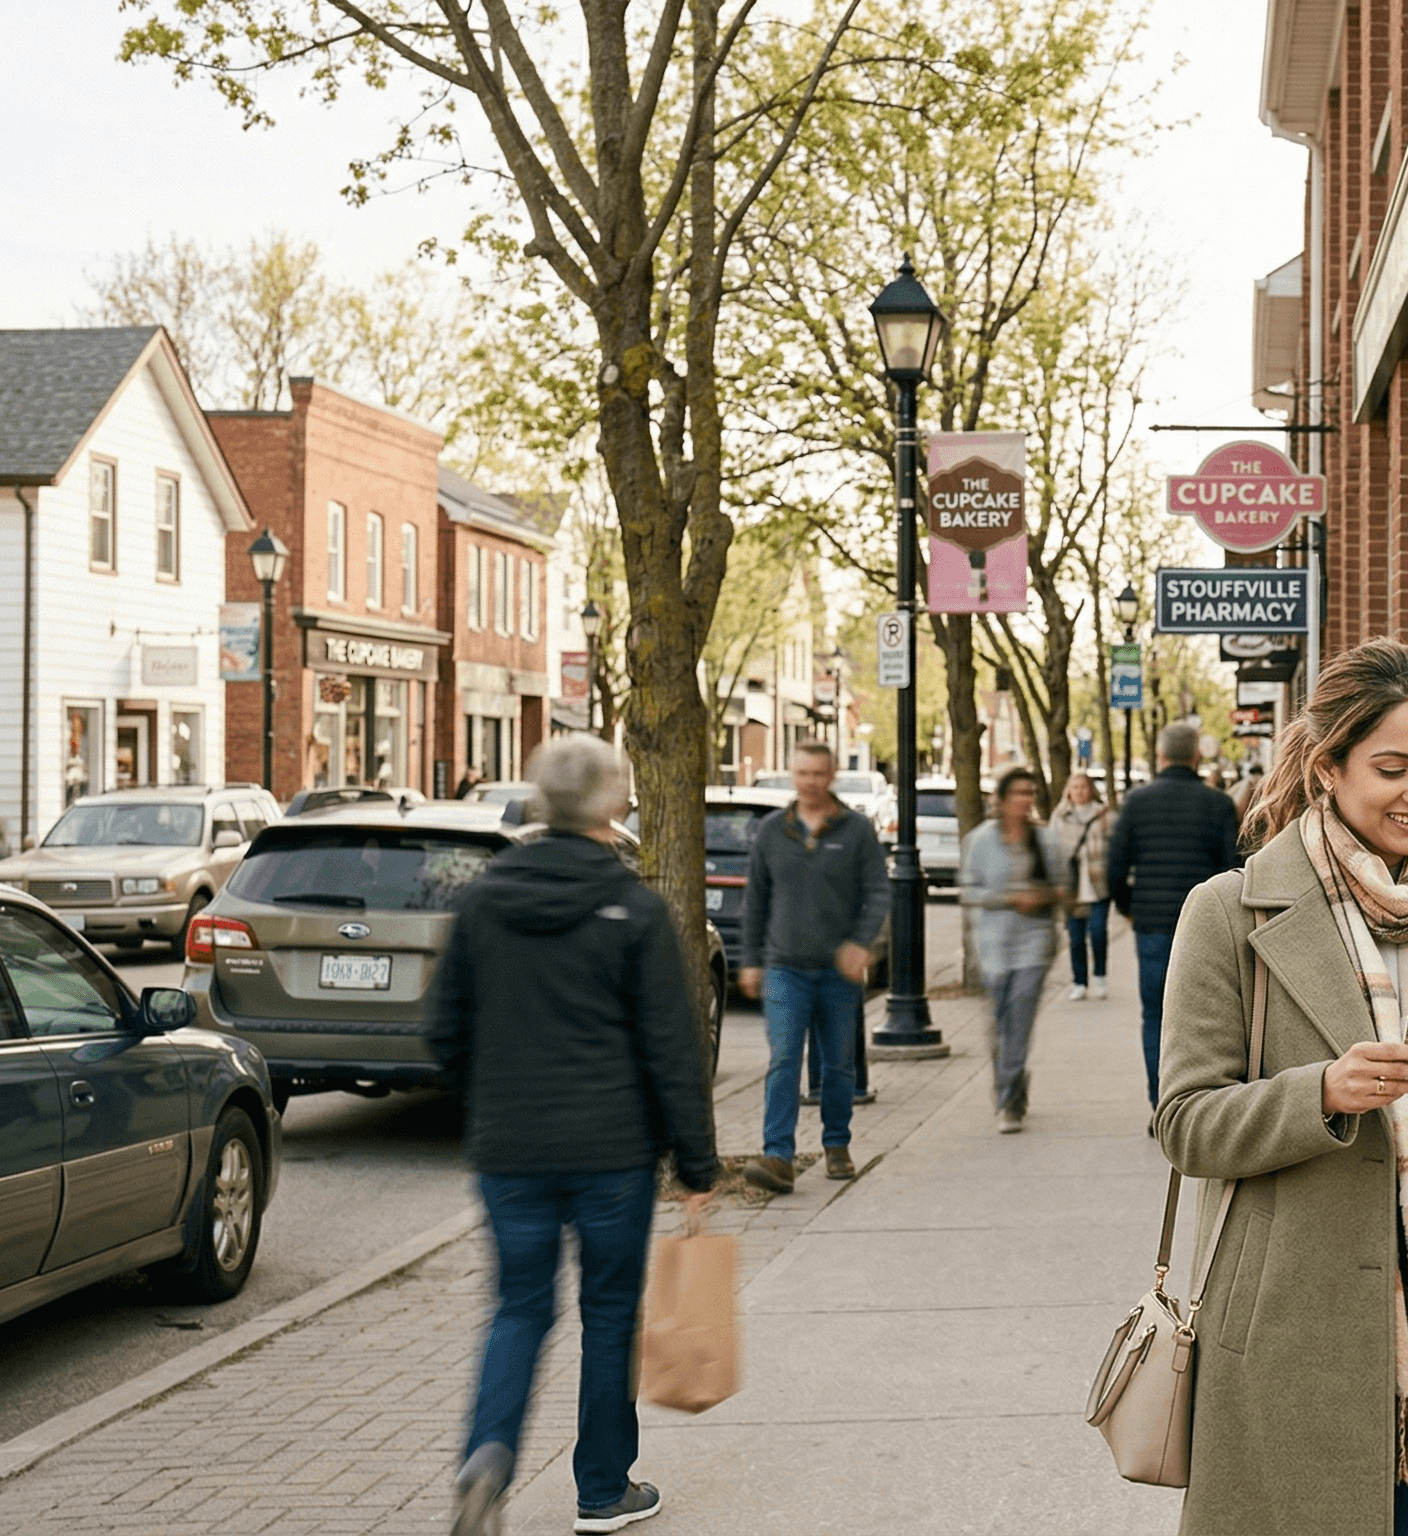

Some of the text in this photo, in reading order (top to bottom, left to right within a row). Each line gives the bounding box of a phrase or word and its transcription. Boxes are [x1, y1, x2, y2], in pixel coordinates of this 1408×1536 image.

[1230, 460, 1262, 474] THE
[962, 477, 990, 491] THE
[932, 492, 1020, 509] CUPCAKE
[1177, 482, 1315, 505] CUPCAKE
[940, 511, 1013, 528] BAKERY
[1215, 510, 1280, 524] BAKERY
[1167, 579, 1301, 598] STOUFFVILLE
[1171, 602, 1297, 622] PHARMACY
